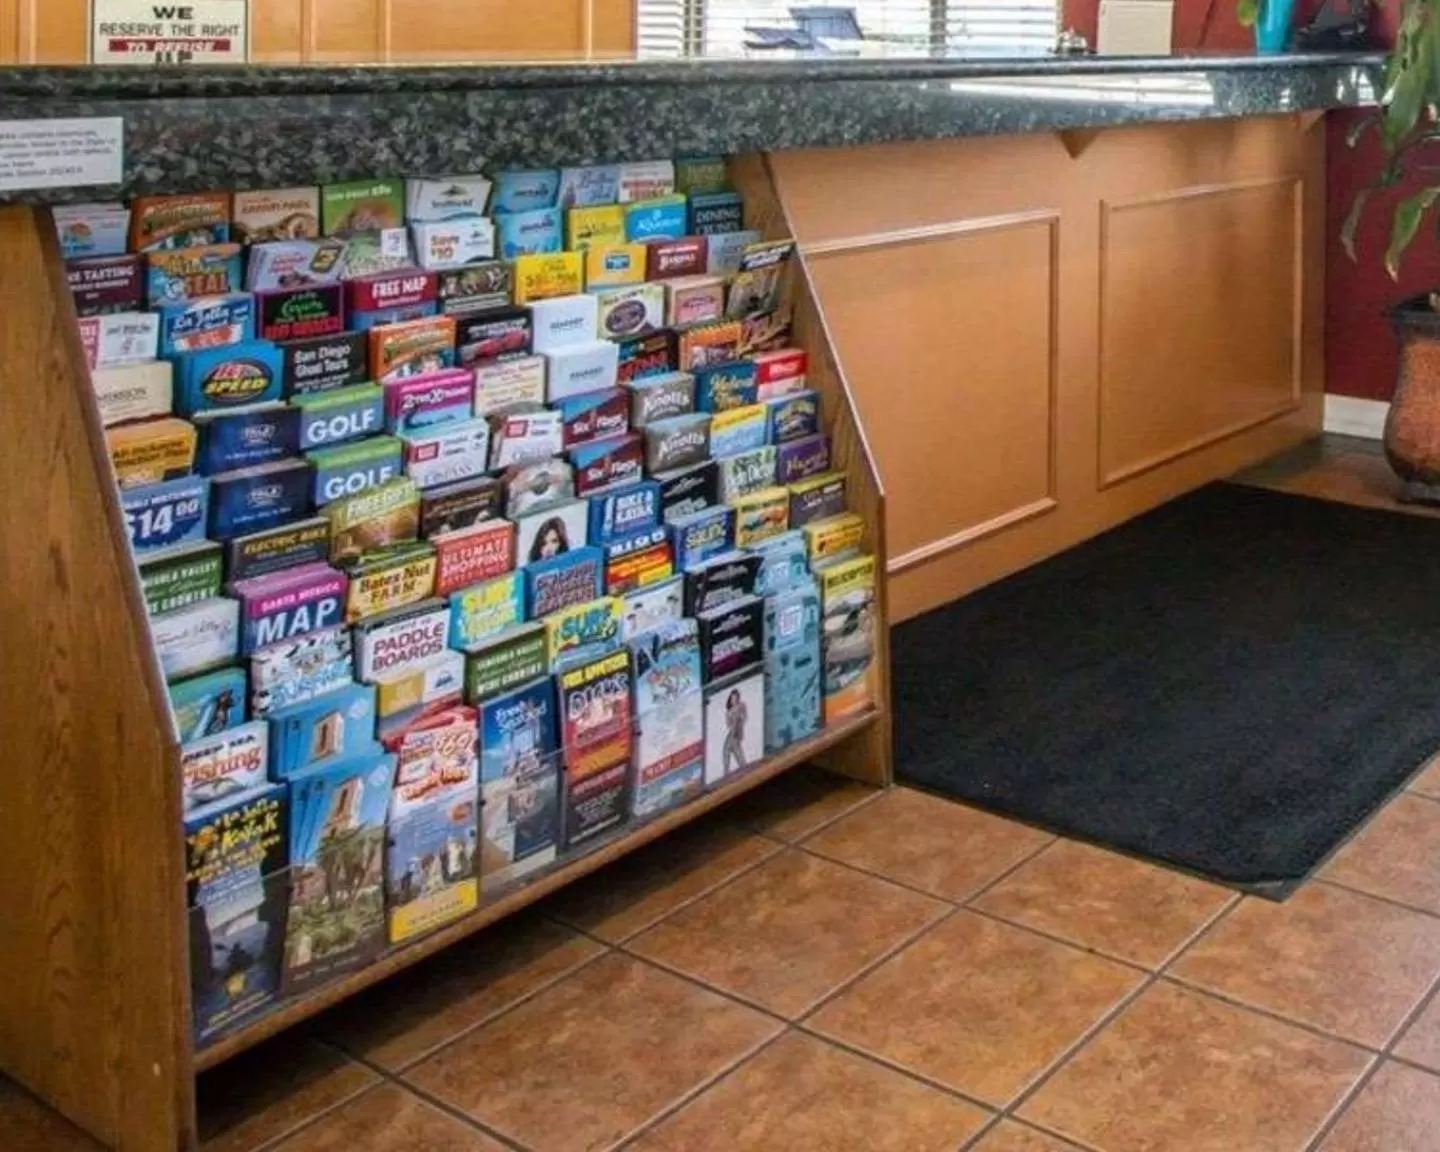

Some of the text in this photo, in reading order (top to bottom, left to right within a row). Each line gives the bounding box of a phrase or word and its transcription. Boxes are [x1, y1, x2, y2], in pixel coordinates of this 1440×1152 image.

[152, 5, 195, 20] WE
[100, 22, 240, 37] RESERVE THE RIGHT
[372, 275, 428, 298] FREE MAP
[294, 343, 351, 366] San Diego
[203, 376, 267, 395] SPEED
[307, 408, 375, 442] GOLF
[572, 417, 589, 435] Six
[325, 466, 392, 499] GOLF
[255, 597, 338, 648] MAP
[373, 621, 445, 656] PADDLE
[372, 639, 444, 672] BOARDS
